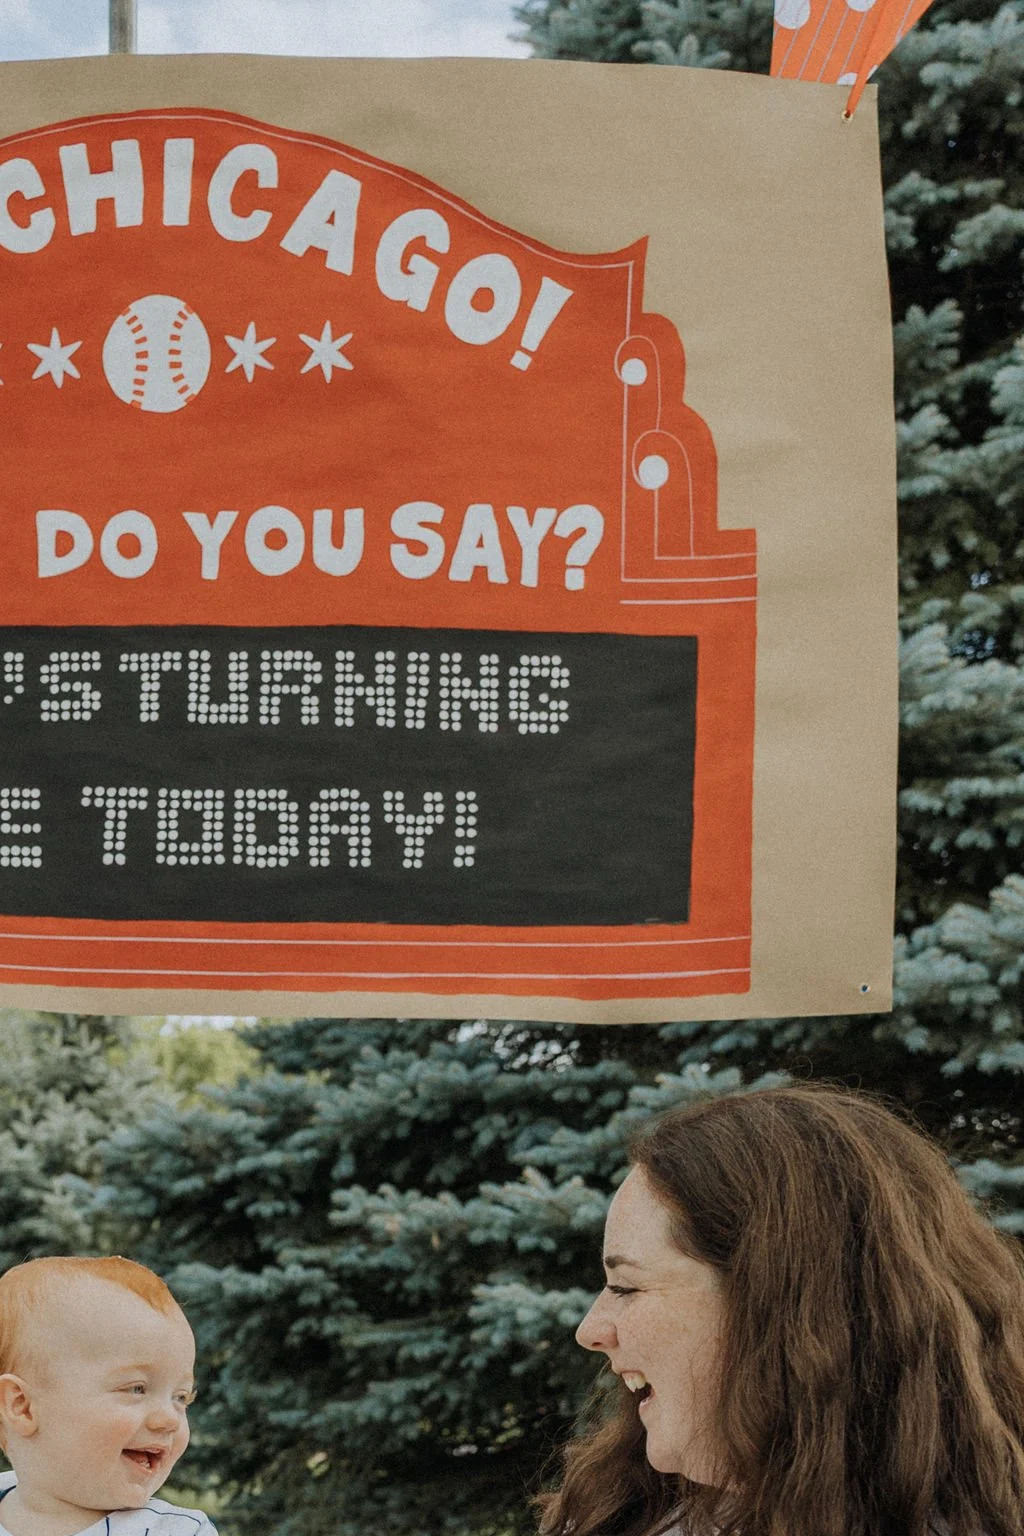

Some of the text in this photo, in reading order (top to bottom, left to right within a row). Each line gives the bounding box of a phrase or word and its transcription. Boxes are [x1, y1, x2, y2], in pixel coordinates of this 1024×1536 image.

[36, 509, 159, 578] DO
[183, 506, 364, 579] YOU
[390, 502, 605, 591] SAY?
[119, 650, 570, 735] TURNING
[82, 786, 478, 869] TODAY!
